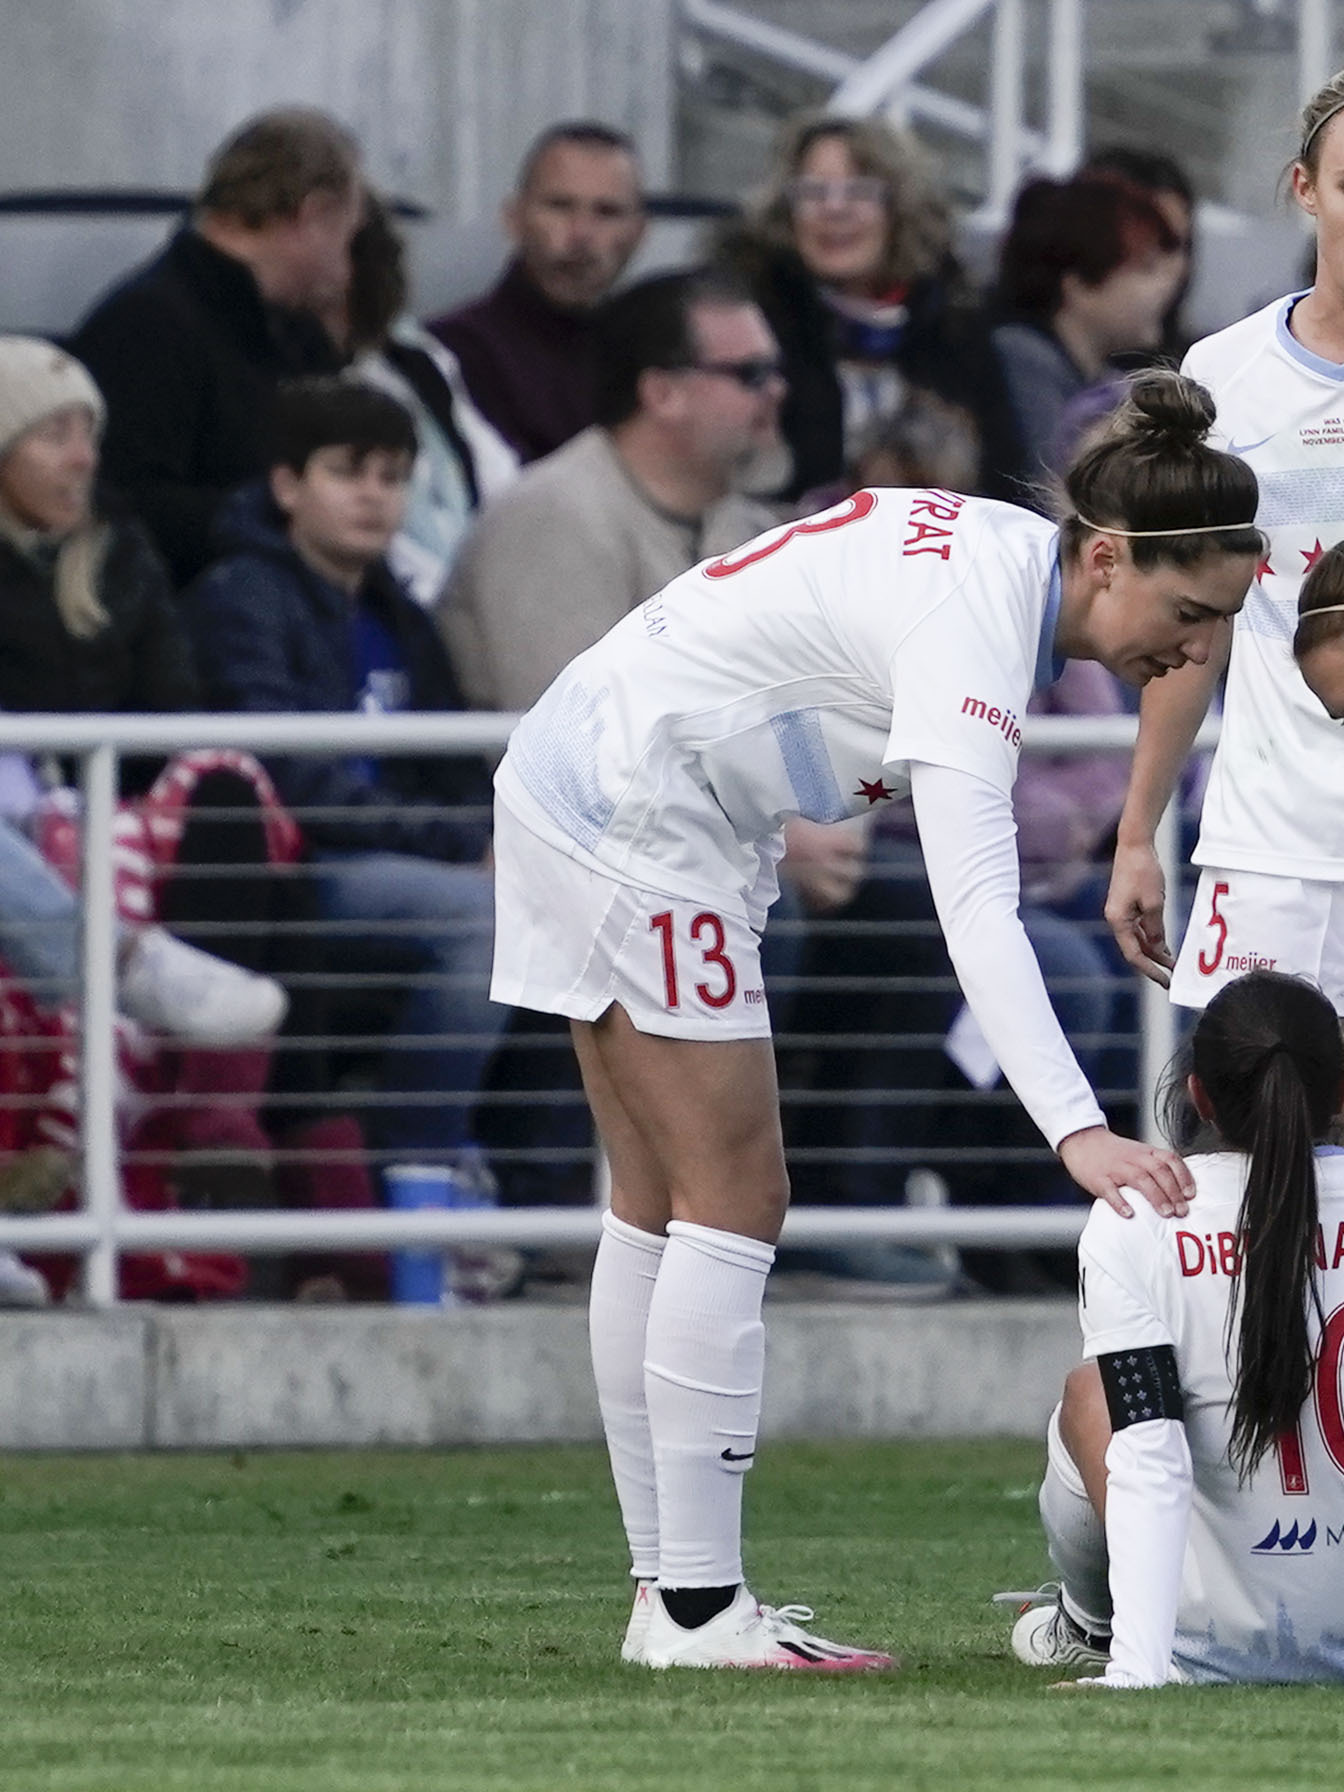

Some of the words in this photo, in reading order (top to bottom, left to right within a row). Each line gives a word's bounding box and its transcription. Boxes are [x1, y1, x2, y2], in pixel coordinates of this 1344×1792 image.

[1299, 428, 1320, 437] LYNN
[649, 909, 737, 1011] 13
[1199, 881, 1229, 977] 5
